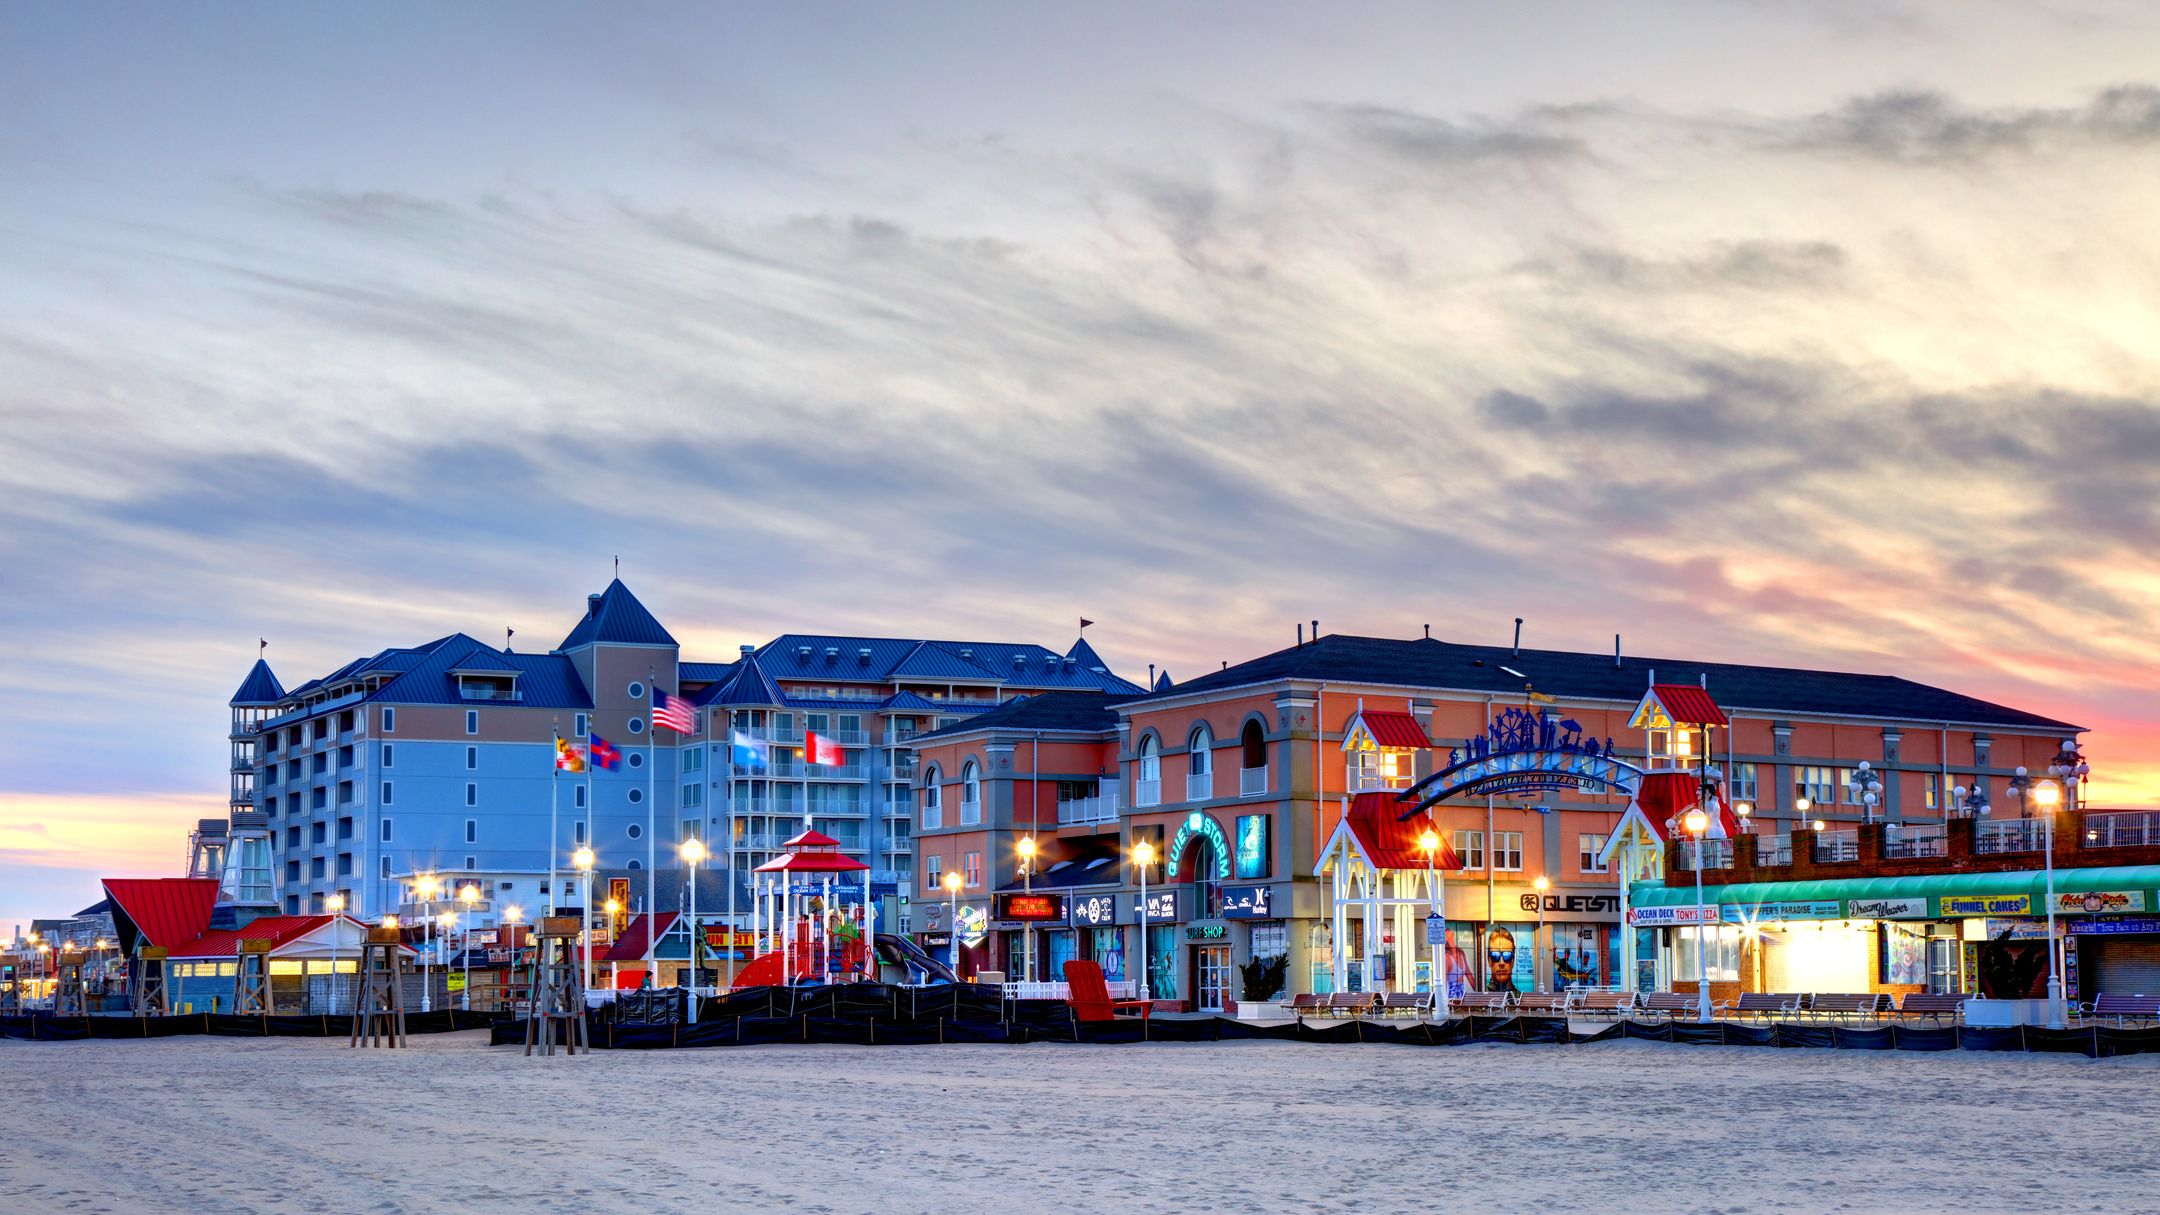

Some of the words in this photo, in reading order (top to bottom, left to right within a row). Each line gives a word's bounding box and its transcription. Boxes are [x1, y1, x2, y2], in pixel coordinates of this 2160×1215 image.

[1168, 821, 1192, 877] QUIET
[1204, 817, 1231, 878] STORM
[1637, 908, 1657, 919] OCEAN
[1658, 908, 1675, 918] DECK
[1781, 905, 1812, 914] PARADISE
[1850, 900, 1879, 918] Dream
[1876, 902, 1909, 917] Weaver
[1951, 902, 1987, 914] FUNNEL
[1988, 901, 2020, 913] CAKES
[1675, 910, 1699, 920] TONY'S
[1702, 909, 1718, 920] IZZA
[1203, 926, 1223, 939] SHOP
[2140, 922, 2155, 933] Any
